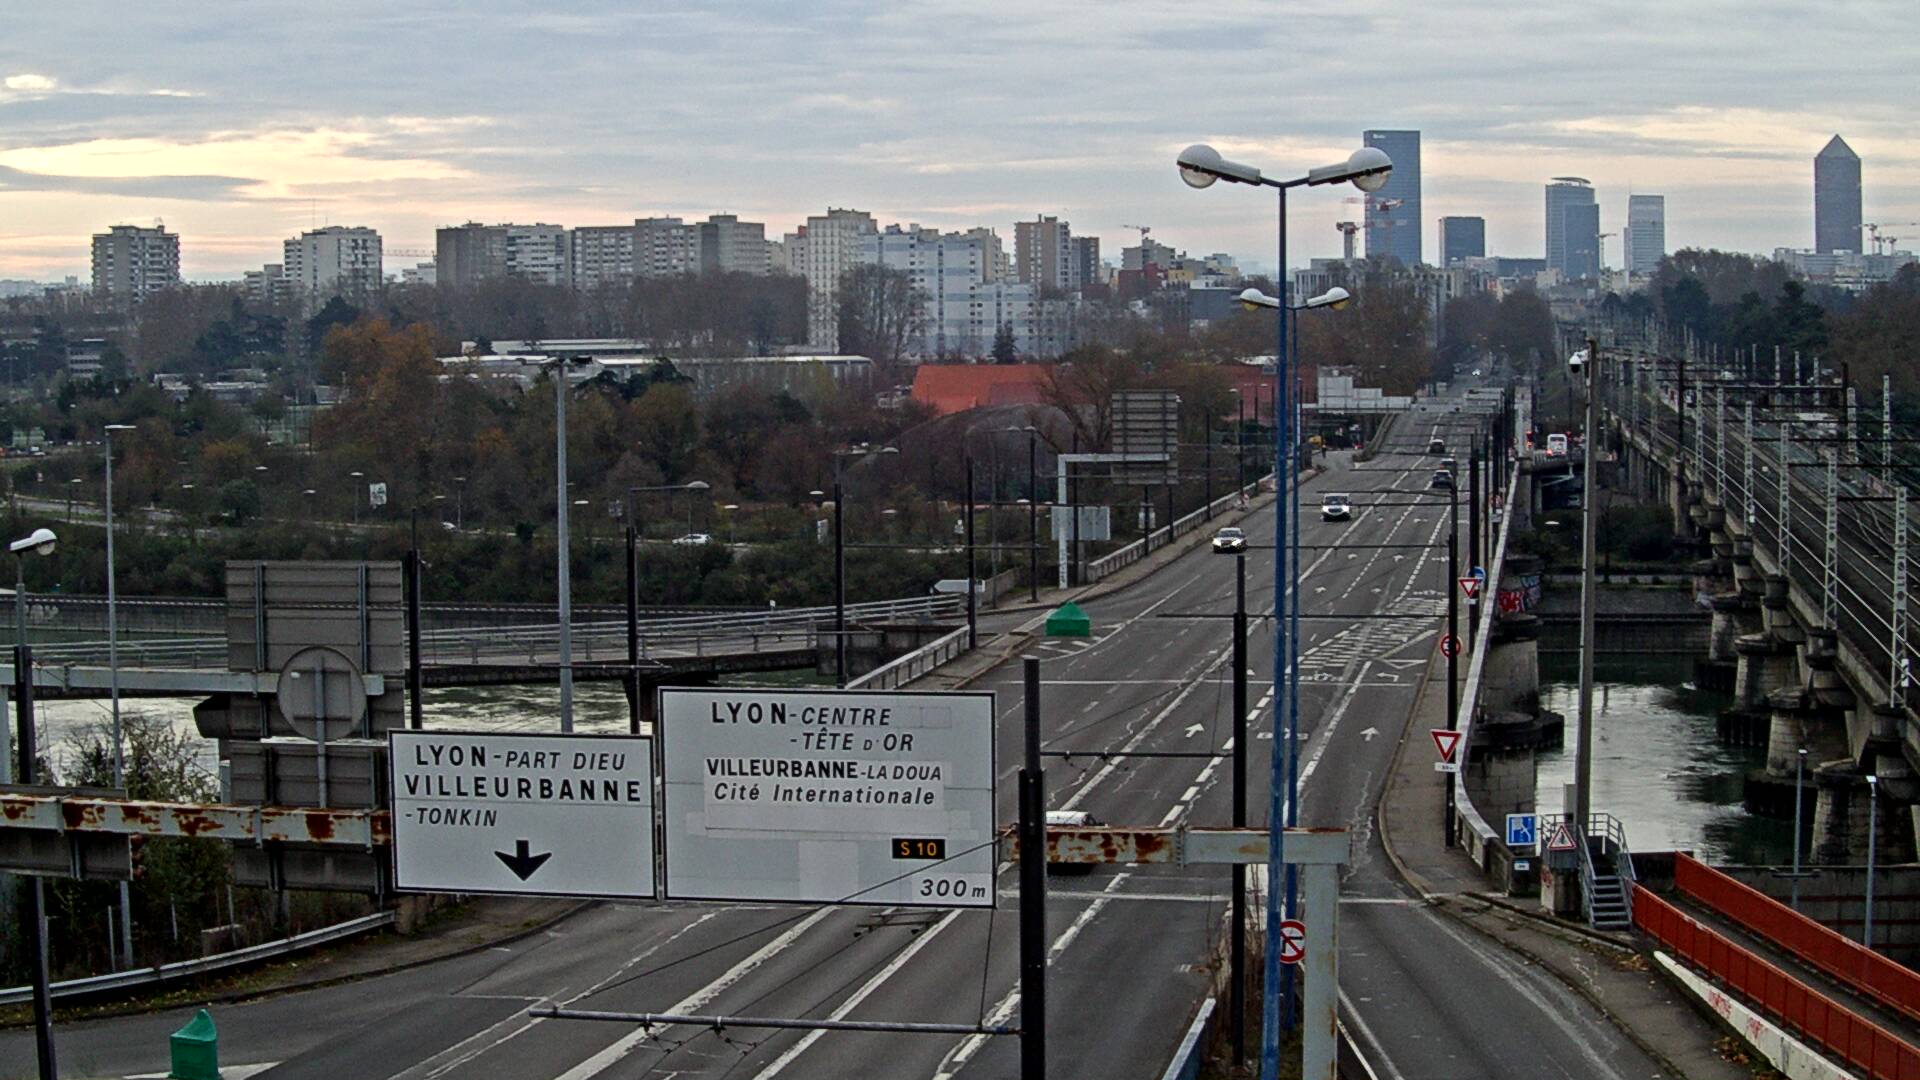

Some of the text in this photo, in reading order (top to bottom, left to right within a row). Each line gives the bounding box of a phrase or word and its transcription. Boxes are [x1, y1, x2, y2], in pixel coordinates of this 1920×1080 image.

[573, 752, 626, 771] DIEU
[405, 775, 641, 802] VILLEURBANNE
[714, 782, 935, 805] Cité Internationale
[405, 807, 498, 827] -TONKIN
